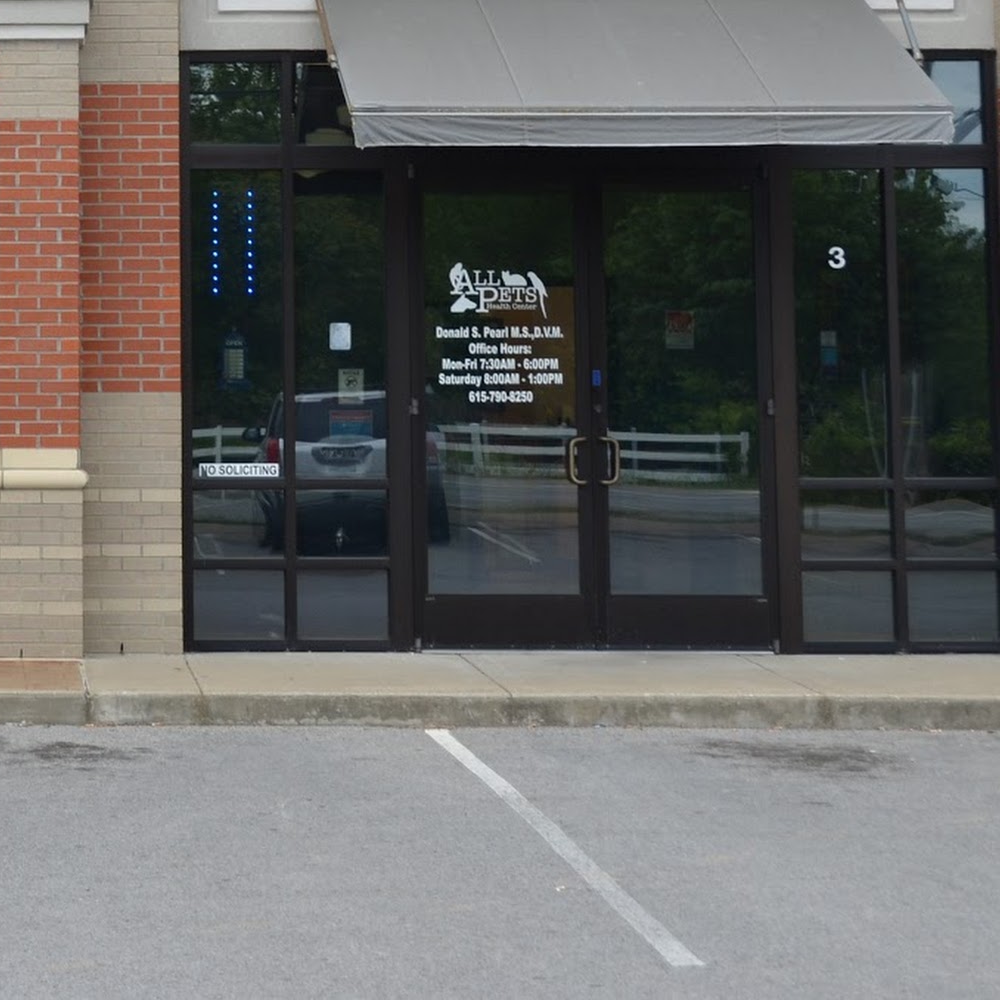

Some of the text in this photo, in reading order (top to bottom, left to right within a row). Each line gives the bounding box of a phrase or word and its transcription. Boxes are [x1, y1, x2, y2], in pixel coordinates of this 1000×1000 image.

[828, 246, 846, 269] 3
[450, 268, 500, 295] ALL
[475, 287, 538, 313] PETS
[436, 326, 469, 339] Donald
[471, 326, 482, 339] S.
[483, 326, 509, 339] Pearl
[468, 343, 532, 355] Office Hours:
[442, 358, 478, 370] Mon-Fri
[480, 358, 516, 370] 7:30AM
[523, 358, 559, 370] 6:00PM
[438, 373, 482, 387] Saturday
[483, 373, 520, 385] 8:00AM
[528, 373, 563, 385] 1:00PM
[468, 390, 534, 403] 615-790-8250
[201, 465, 277, 476] NO SOLICITING
